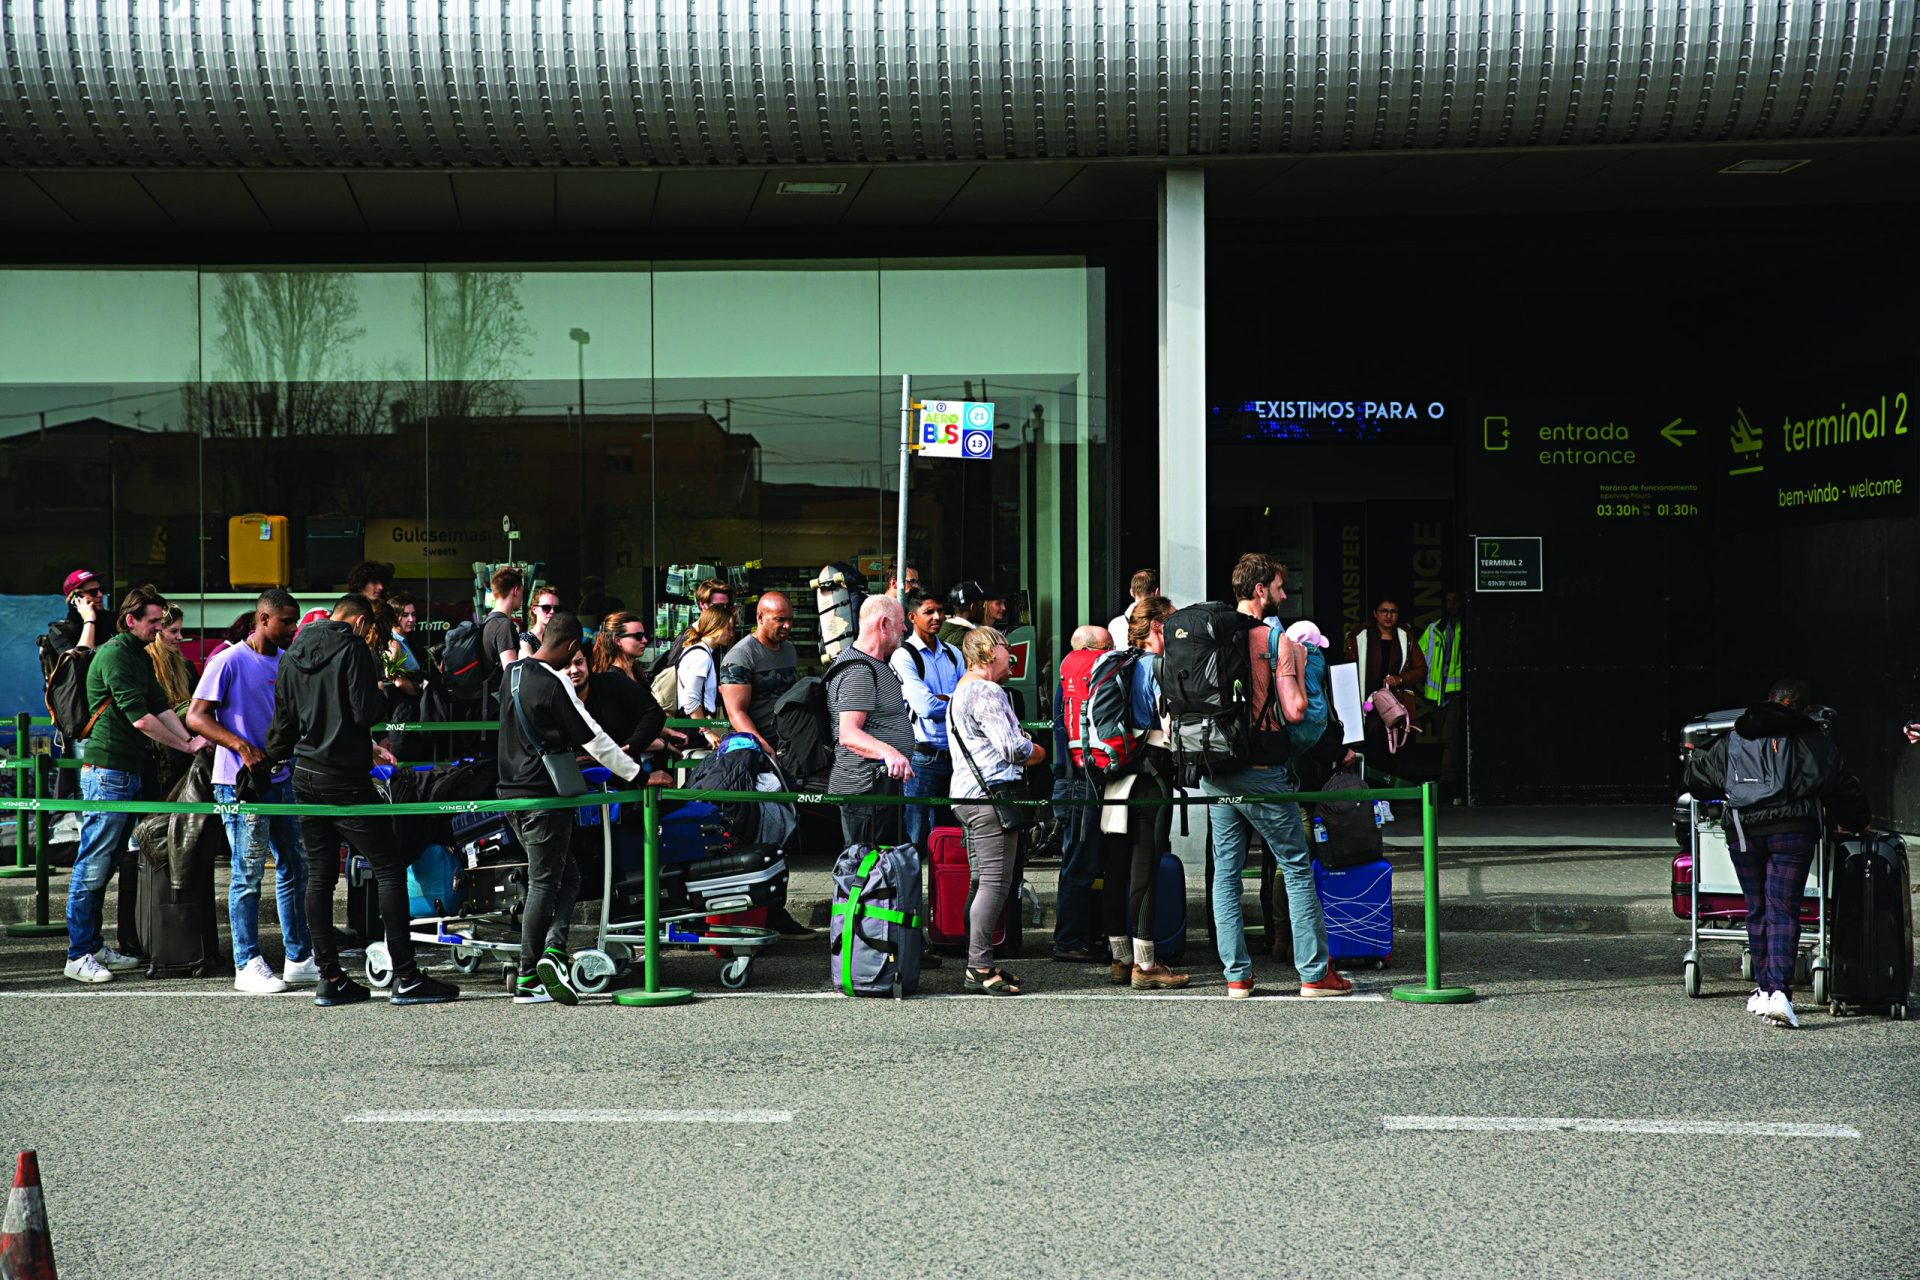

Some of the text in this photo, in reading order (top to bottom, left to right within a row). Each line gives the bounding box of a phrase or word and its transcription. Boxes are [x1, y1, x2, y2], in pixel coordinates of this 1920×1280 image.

[974, 412, 985, 420] 21
[1255, 401, 1445, 419] EXISTIMOS PARA O
[924, 413, 958, 423] AERO
[1782, 392, 1909, 453] terminal 2
[923, 423, 958, 444] BUS
[1538, 421, 1630, 441] entrada
[972, 440, 983, 448] 13
[1538, 447, 1637, 464] entrance
[1629, 483, 1639, 492] de
[1778, 481, 1839, 508] bem-vindo
[1848, 477, 1903, 499] welcome
[1596, 503, 1641, 516] 03:30h
[1656, 503, 1699, 516] 01:30h
[423, 546, 457, 556] Sweets
[1479, 541, 1501, 558] T2
[1480, 559, 1523, 567] TERMINAL 2
[417, 620, 451, 632] TOTTO
